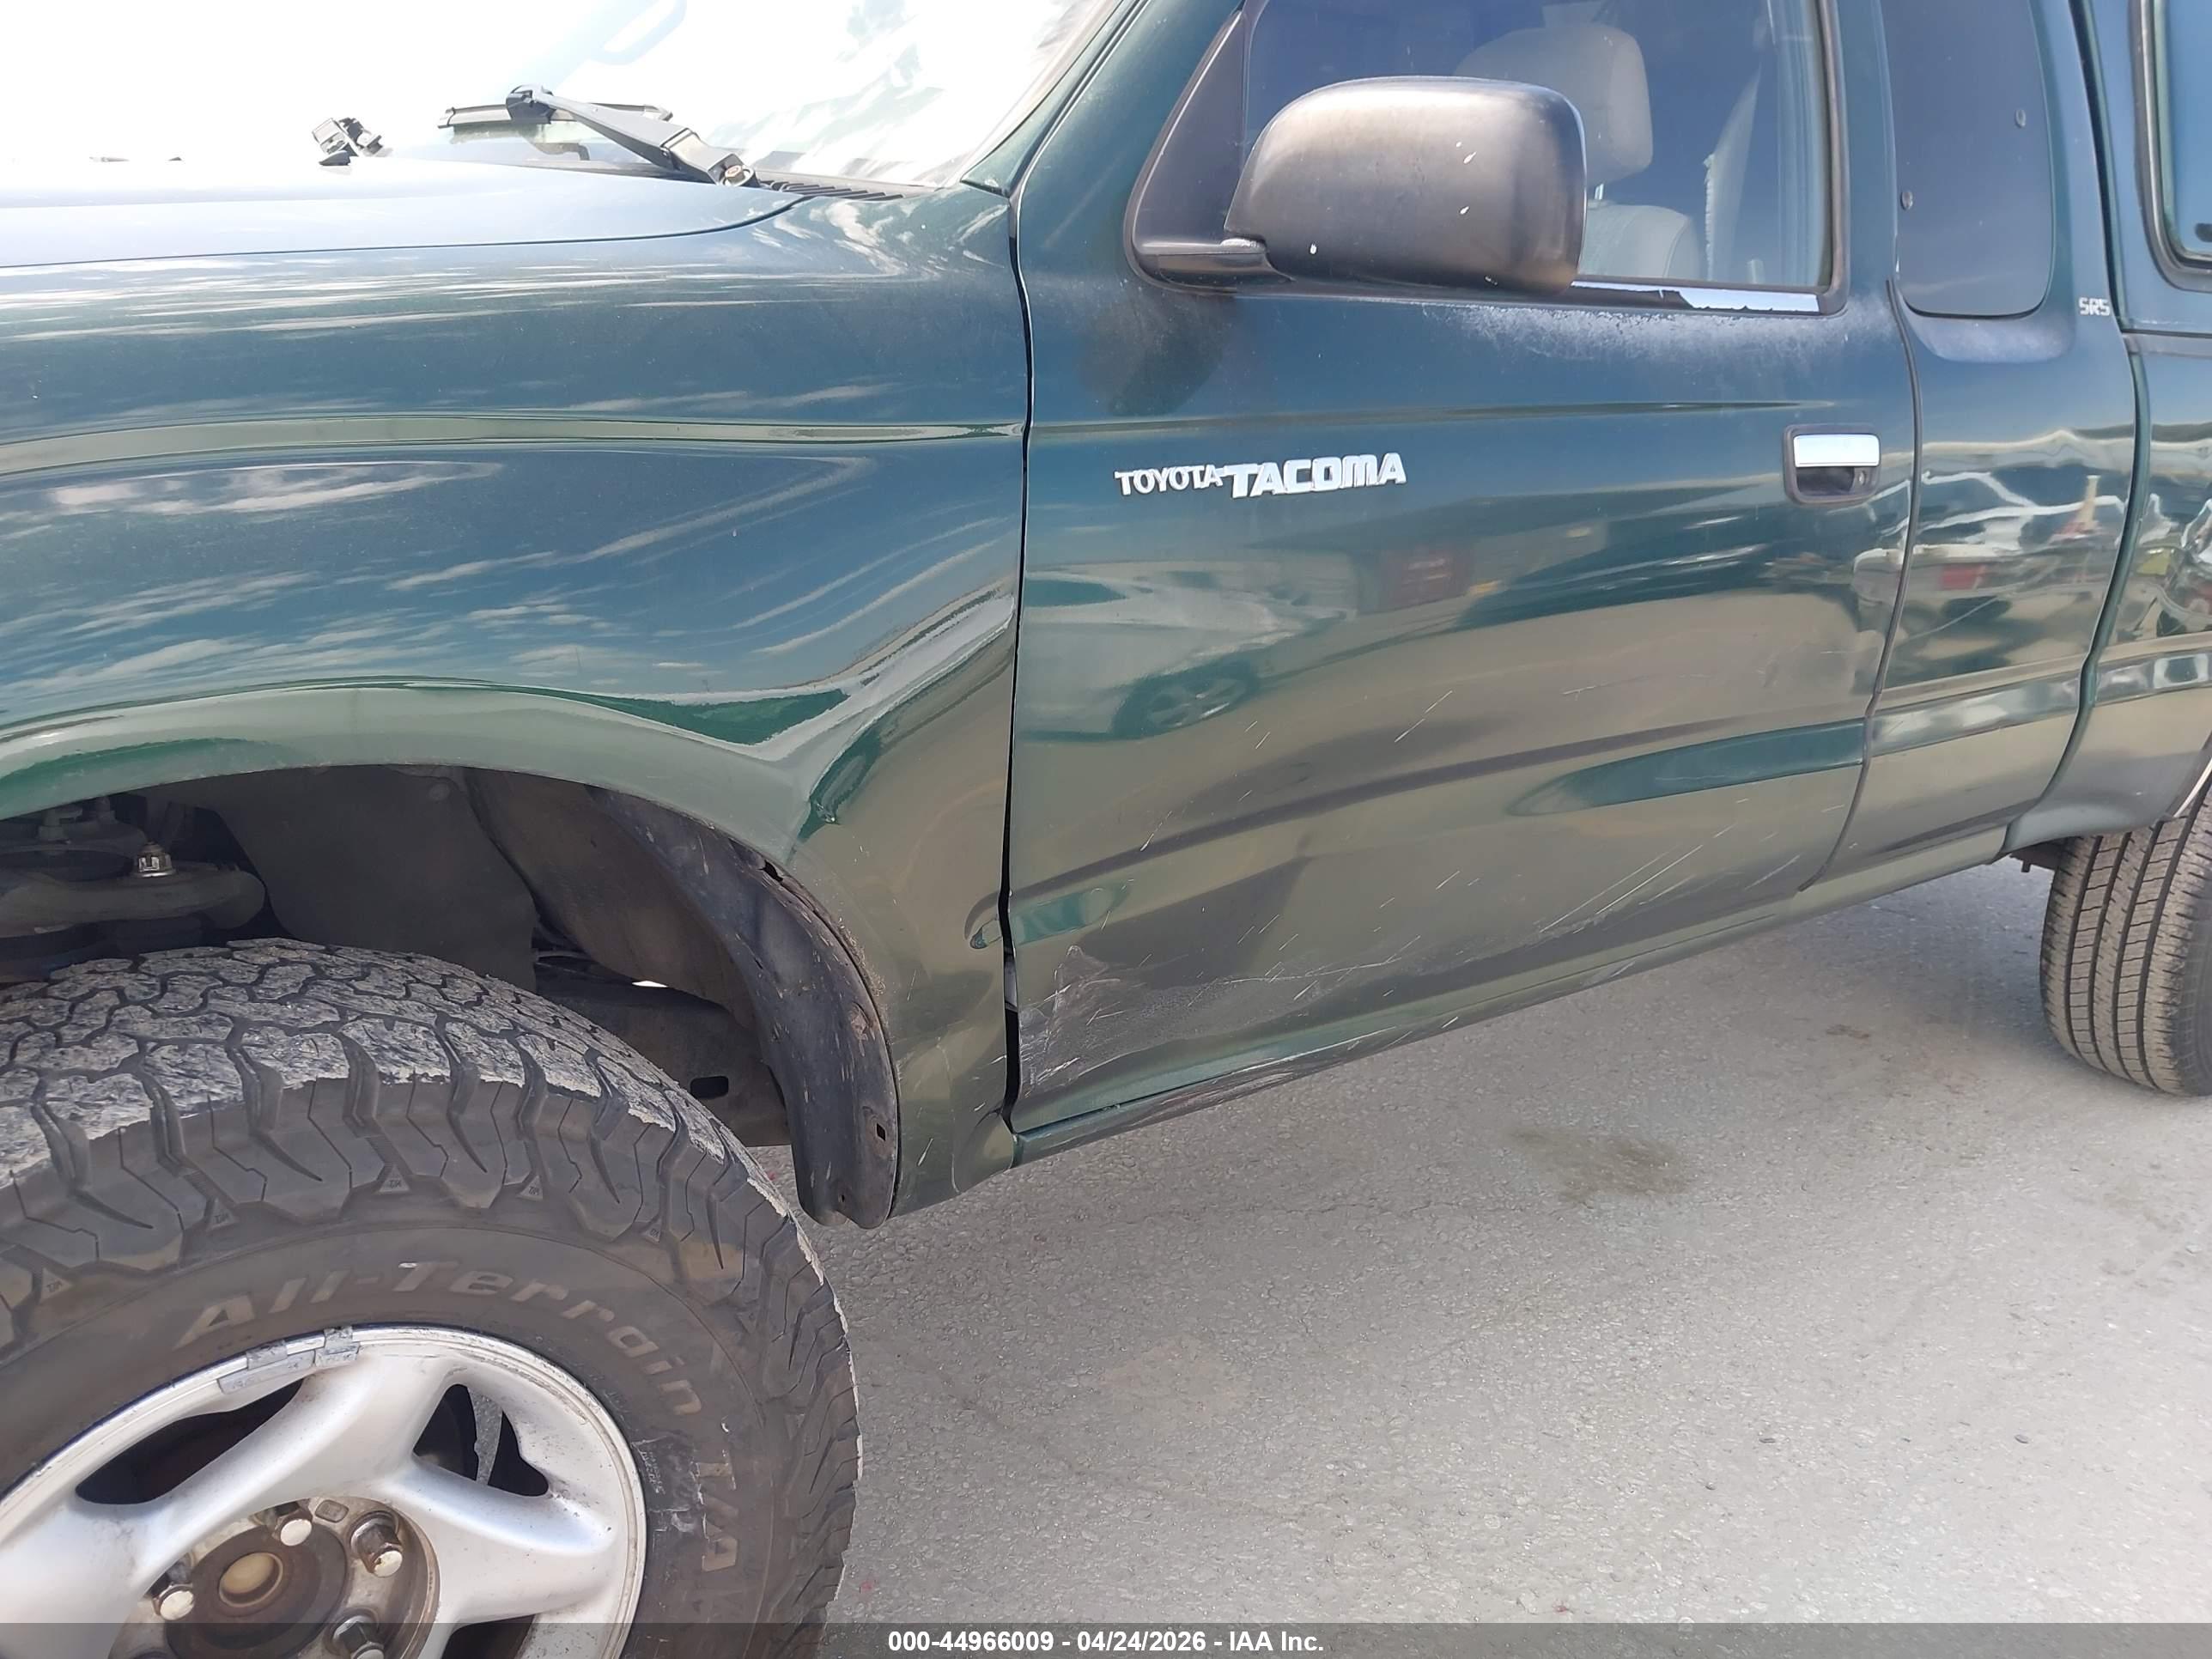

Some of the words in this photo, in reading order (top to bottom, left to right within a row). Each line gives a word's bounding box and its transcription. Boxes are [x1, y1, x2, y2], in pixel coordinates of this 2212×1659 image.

[2078, 296, 2111, 317] SR5
[1115, 464, 1224, 495] TOYOTA
[1223, 452, 1407, 499] TACOMA
[172, 1261, 702, 1415] All-Terrain
